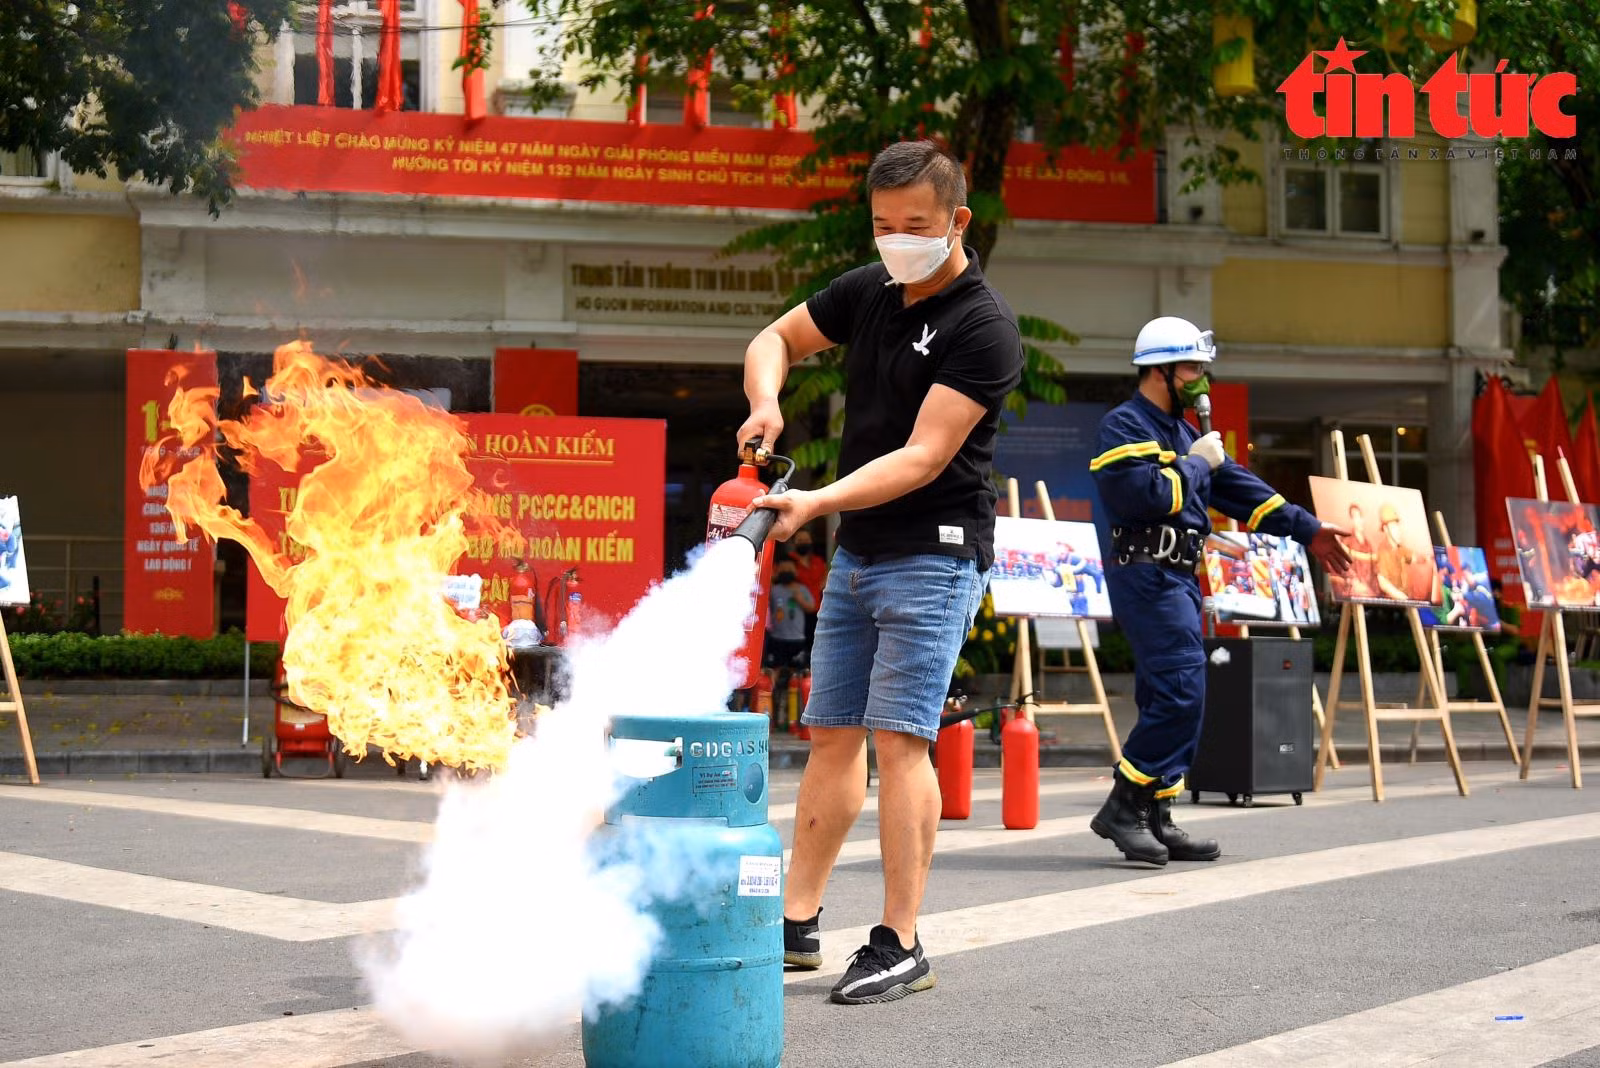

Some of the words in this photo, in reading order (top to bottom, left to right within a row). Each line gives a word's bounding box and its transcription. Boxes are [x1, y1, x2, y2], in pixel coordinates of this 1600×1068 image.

[297, 127, 330, 147] LIỆT
[335, 131, 381, 150] CHÀO
[384, 134, 430, 151] MỪNG
[434, 136, 454, 151] KỶ
[459, 137, 497, 155] NIỆM
[501, 142, 517, 154] 47
[520, 141, 555, 157] NĂM
[558, 142, 600, 158] NGÀY
[604, 144, 634, 160] GIẢI
[638, 147, 689, 163] PHÓNG
[694, 148, 729, 163] MIỀN
[733, 153, 765, 166] NAM
[507, 160, 544, 176] NIỆM
[548, 163, 573, 176] 132
[576, 162, 609, 178] NĂM
[612, 164, 654, 181] NGÀY
[658, 168, 693, 182] SINH
[696, 166, 728, 184] CHỦ
[731, 171, 765, 187] TỊCH
[631, 299, 706, 314] INFORMATION
[707, 301, 732, 315] AND
[485, 429, 551, 454] HOÀN
[555, 428, 616, 456] KIẾM
[519, 494, 636, 521] PCCC&CNCH
[528, 532, 581, 561] HOÀN
[586, 529, 634, 562] KIẾM
